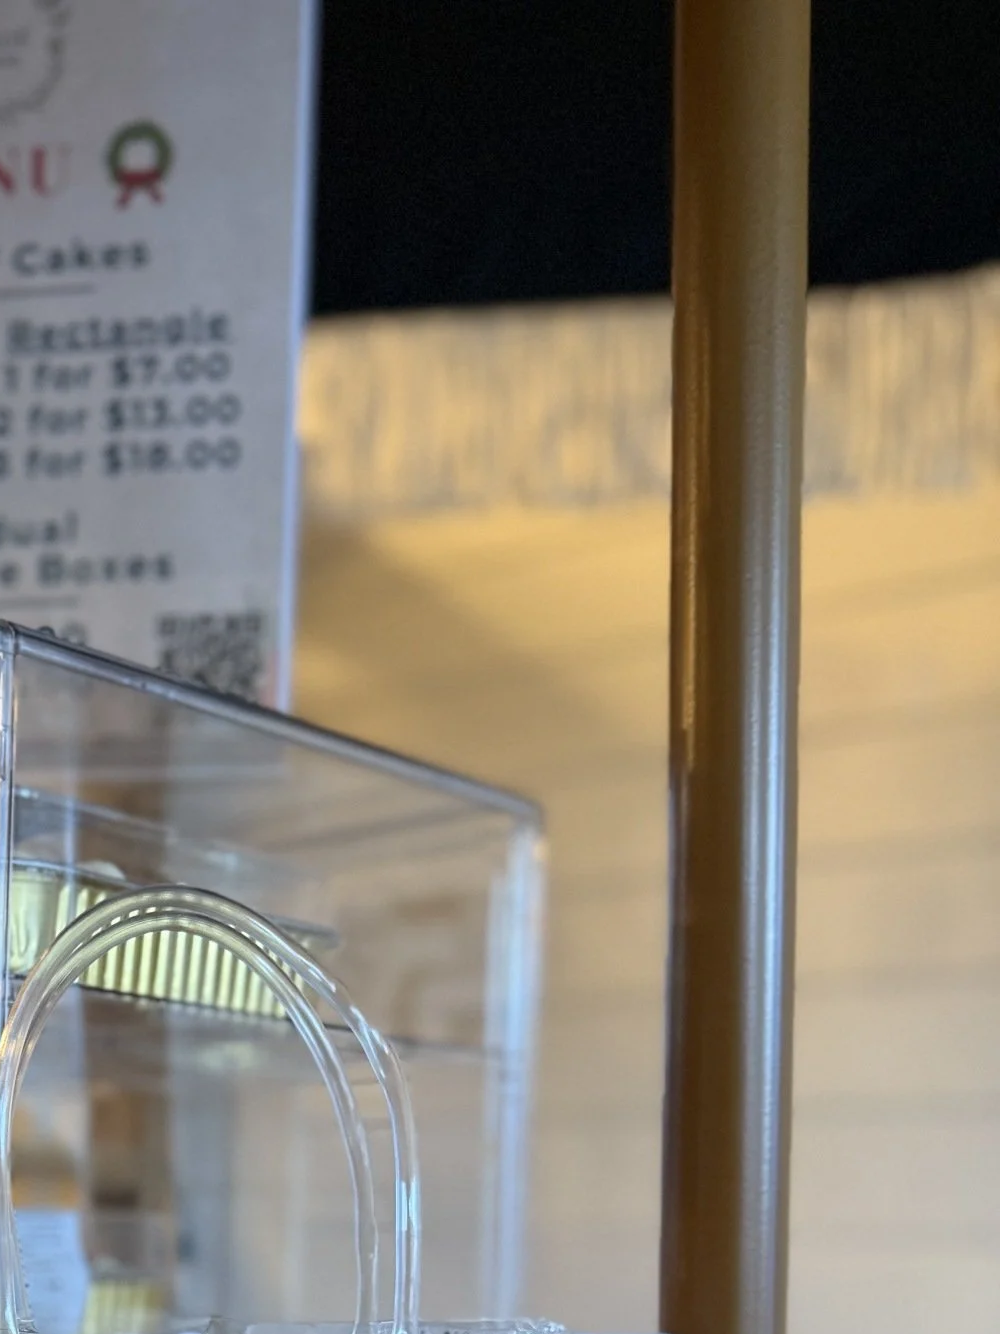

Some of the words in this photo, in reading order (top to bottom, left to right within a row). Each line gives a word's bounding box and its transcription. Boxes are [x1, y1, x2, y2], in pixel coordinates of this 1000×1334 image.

[11, 238, 149, 277] Cakes
[4, 360, 20, 394] 1
[31, 358, 93, 393] for
[113, 351, 231, 389] $7.00
[26, 402, 87, 437] for
[25, 444, 85, 480] for
[37, 552, 174, 588] Boxes
